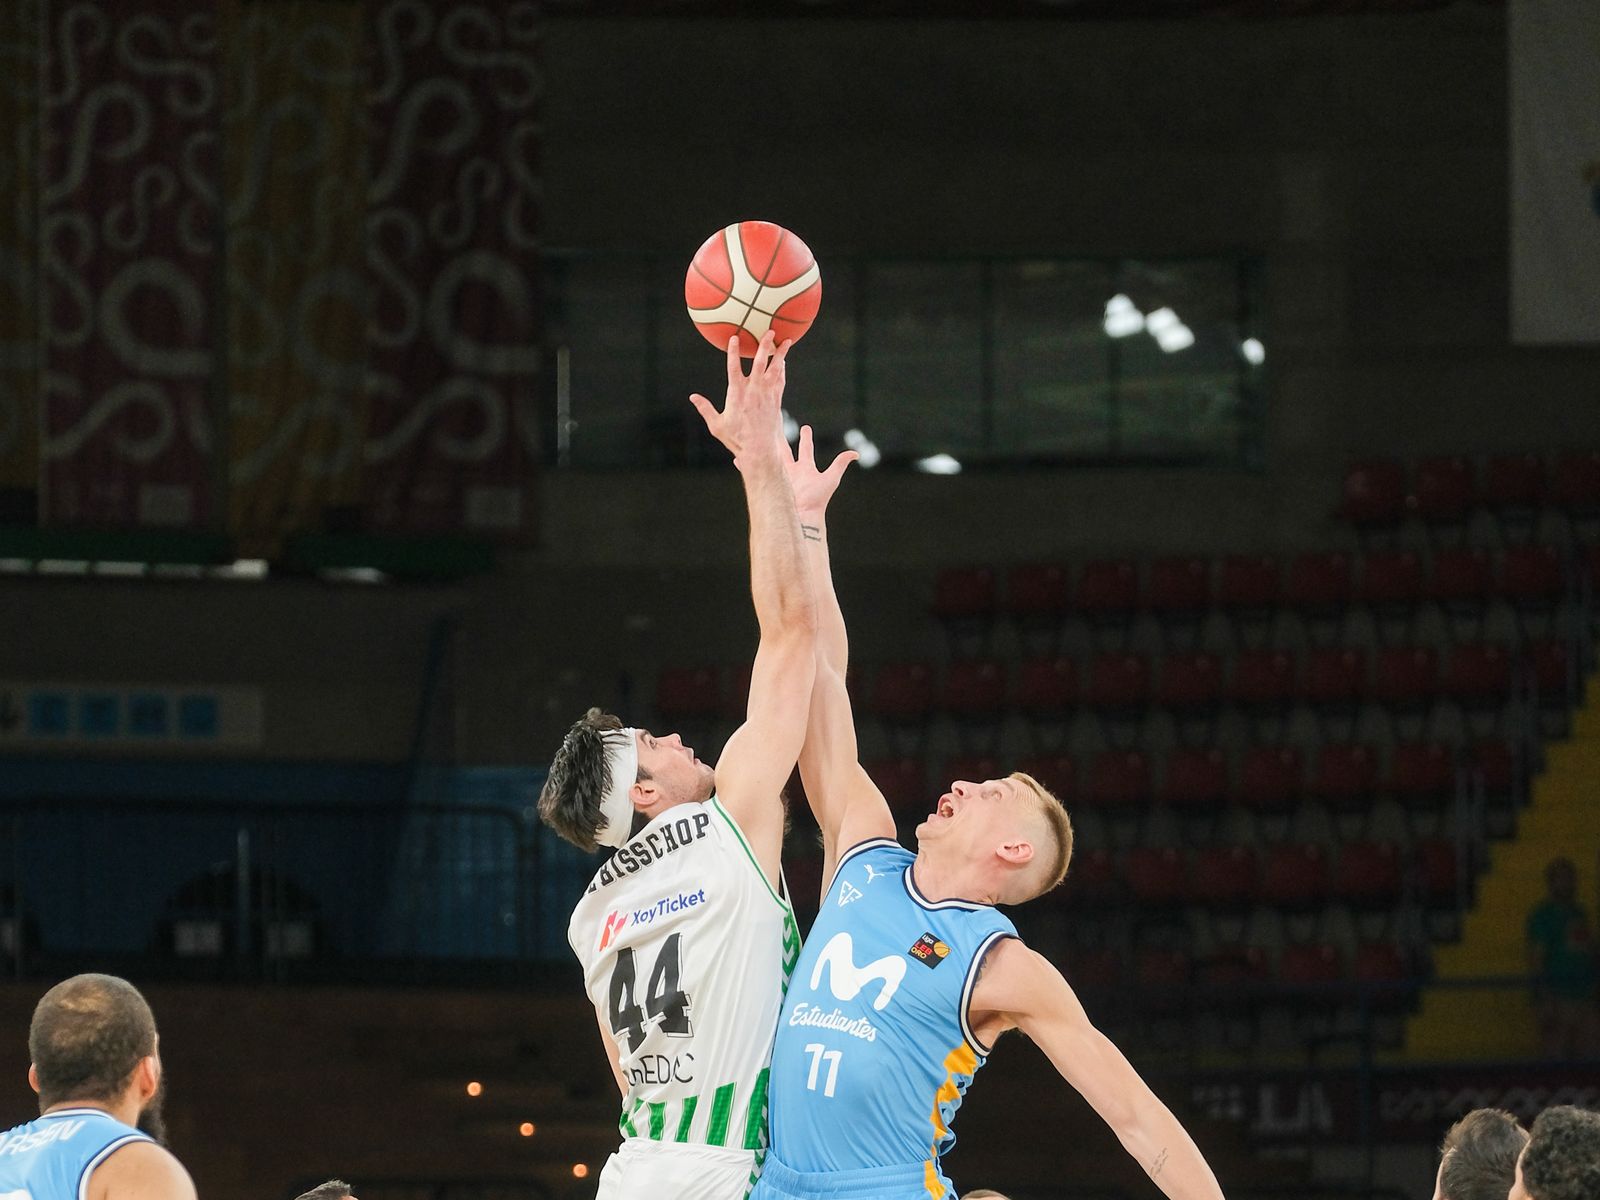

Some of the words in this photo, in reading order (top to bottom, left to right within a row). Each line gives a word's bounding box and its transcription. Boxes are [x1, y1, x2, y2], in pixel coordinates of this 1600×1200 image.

[588, 812, 710, 893] BISSCHOP
[631, 889, 705, 927] XoyTicket
[608, 932, 694, 1055] 44
[789, 1002, 877, 1042] Estudiantes
[804, 1043, 843, 1098] 11
